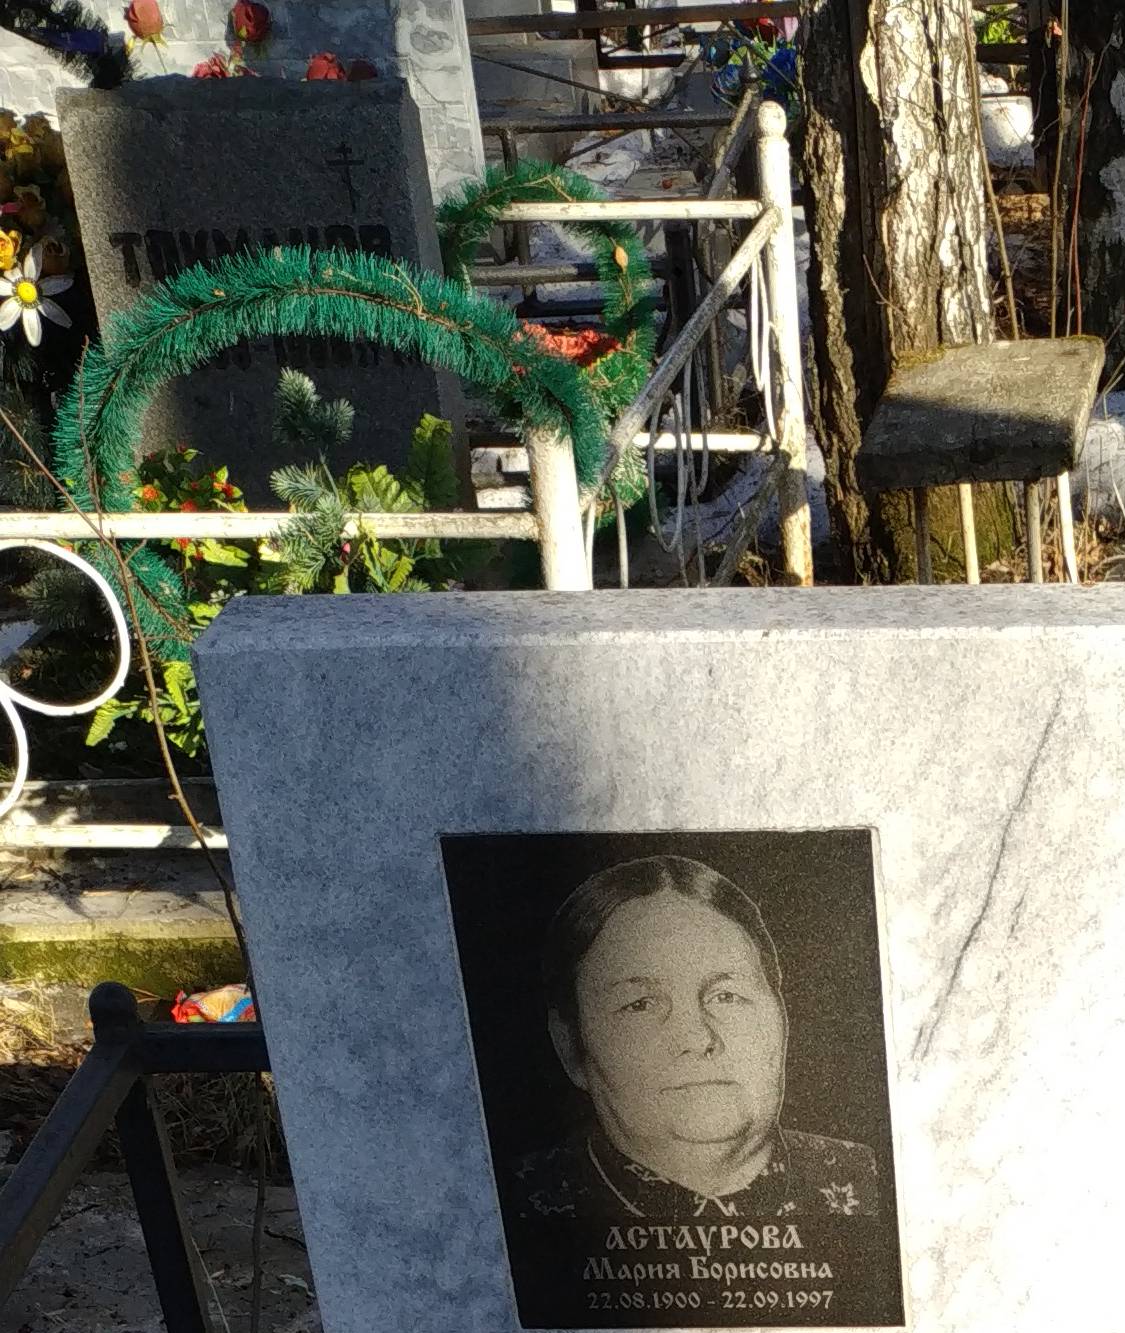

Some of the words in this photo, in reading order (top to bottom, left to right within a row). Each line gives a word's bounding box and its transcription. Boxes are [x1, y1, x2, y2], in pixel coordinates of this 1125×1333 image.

[583, 1257, 682, 1286] Мария
[688, 1256, 834, 1286] Борисовна
[588, 1292, 701, 1309] 22.08.1900
[721, 1290, 835, 1309] 22.09.1997
